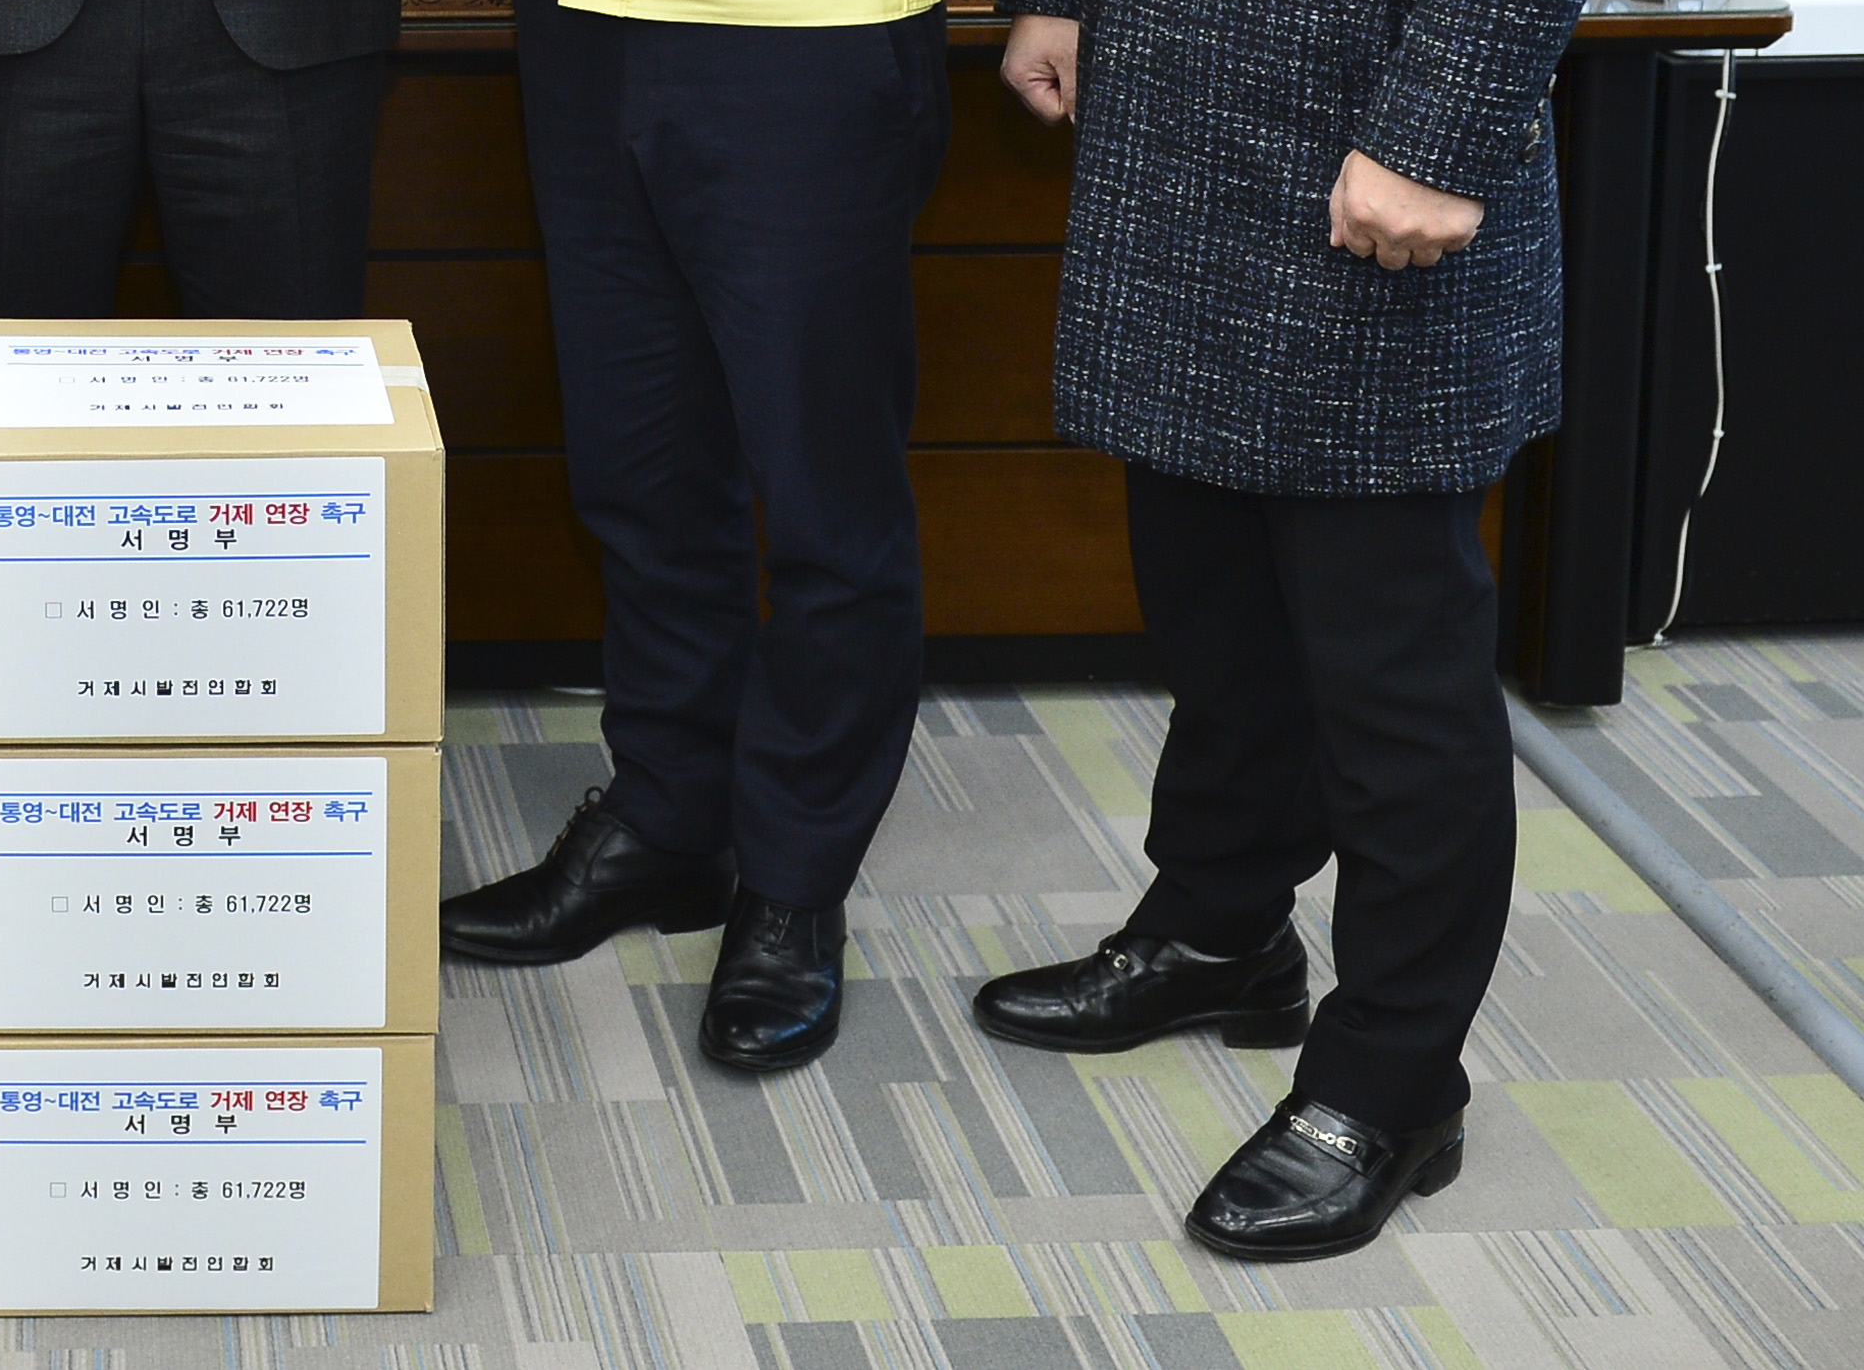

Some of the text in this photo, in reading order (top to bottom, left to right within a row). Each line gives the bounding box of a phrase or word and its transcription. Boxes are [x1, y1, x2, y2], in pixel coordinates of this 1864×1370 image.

[107, 504, 198, 527] 고속도로
[209, 503, 253, 526] 거제
[265, 502, 311, 525] 연장
[320, 501, 367, 525] 촉구
[191, 599, 209, 620] 총
[222, 598, 308, 619] 61,722명
[0, 800, 369, 824] 통영~대전 고속도로 거제 연장 촉구
[195, 894, 213, 914] 총
[226, 894, 311, 914] 61,722명
[0, 1090, 363, 1113] 통영~대전 고속도로 거제 연장 촉구
[191, 1181, 209, 1200] 총
[222, 1181, 306, 1200] 61,722명
